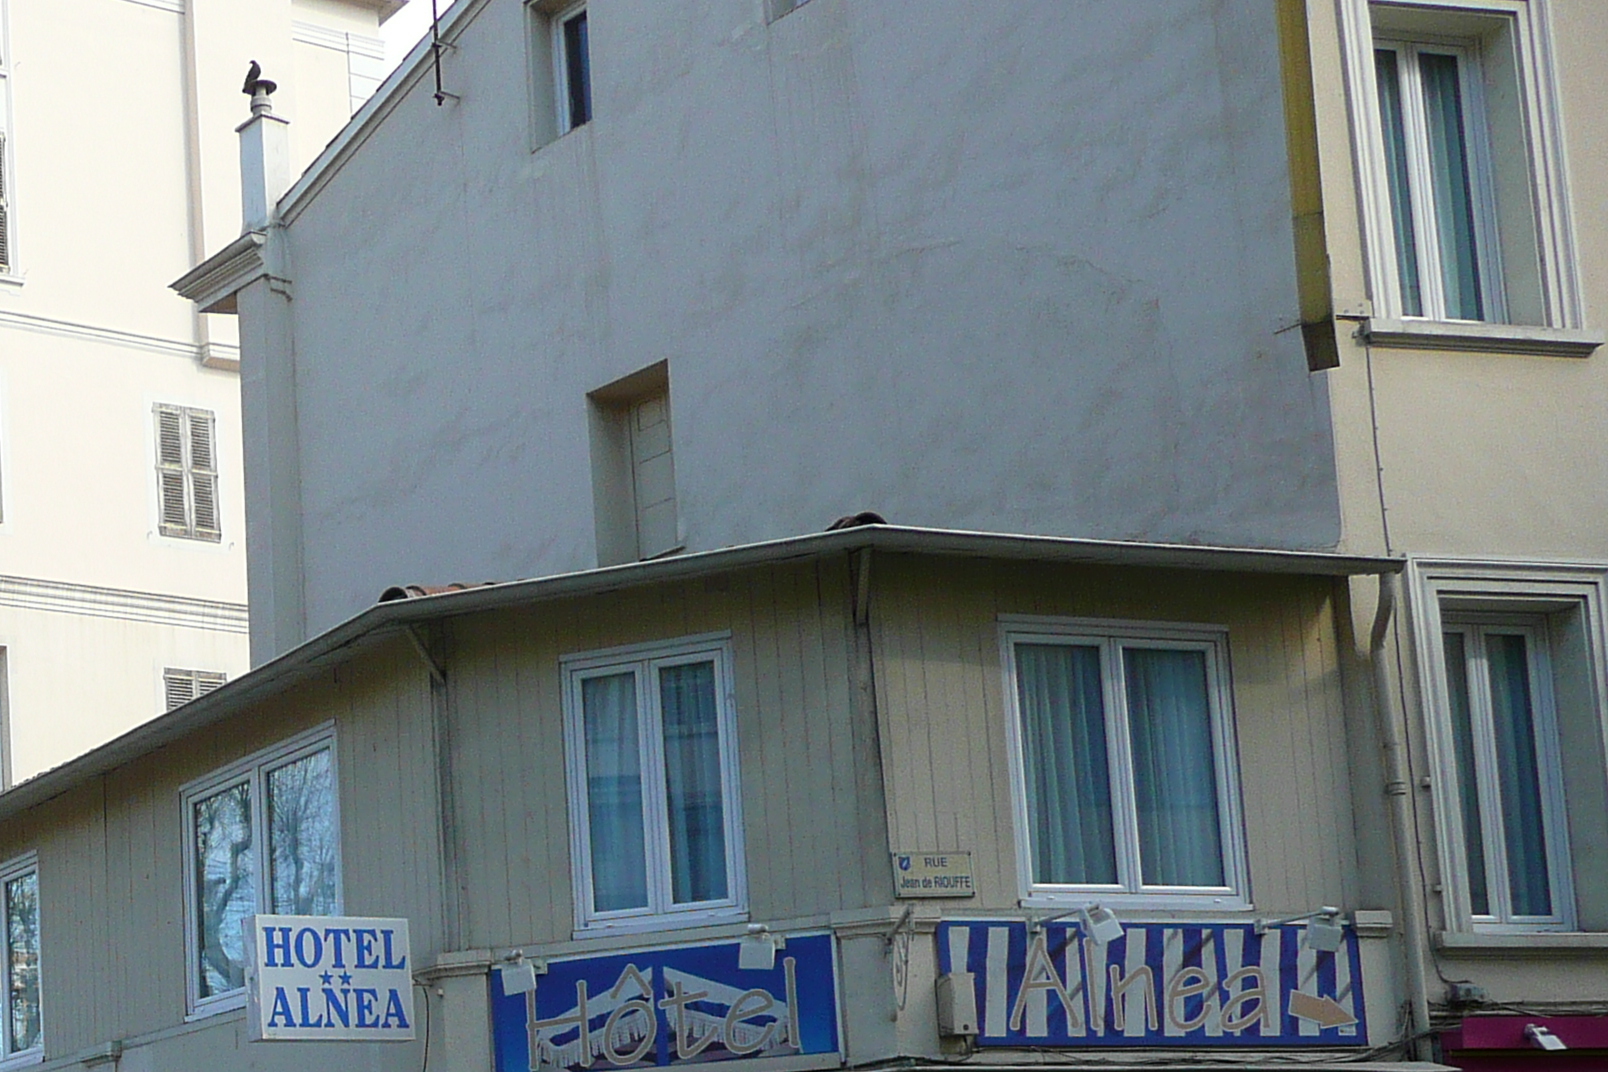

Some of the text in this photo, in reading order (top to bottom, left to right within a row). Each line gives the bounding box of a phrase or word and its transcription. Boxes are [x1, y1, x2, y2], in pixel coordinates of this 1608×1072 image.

[900, 875, 920, 889] Jean
[933, 875, 971, 889] RIOUFFE
[924, 857, 948, 868] RUE
[262, 926, 407, 970] HOTEL
[1009, 935, 1271, 1034] Alnea
[266, 986, 410, 1030] ALNEA
[524, 955, 801, 1072] Hôtel
